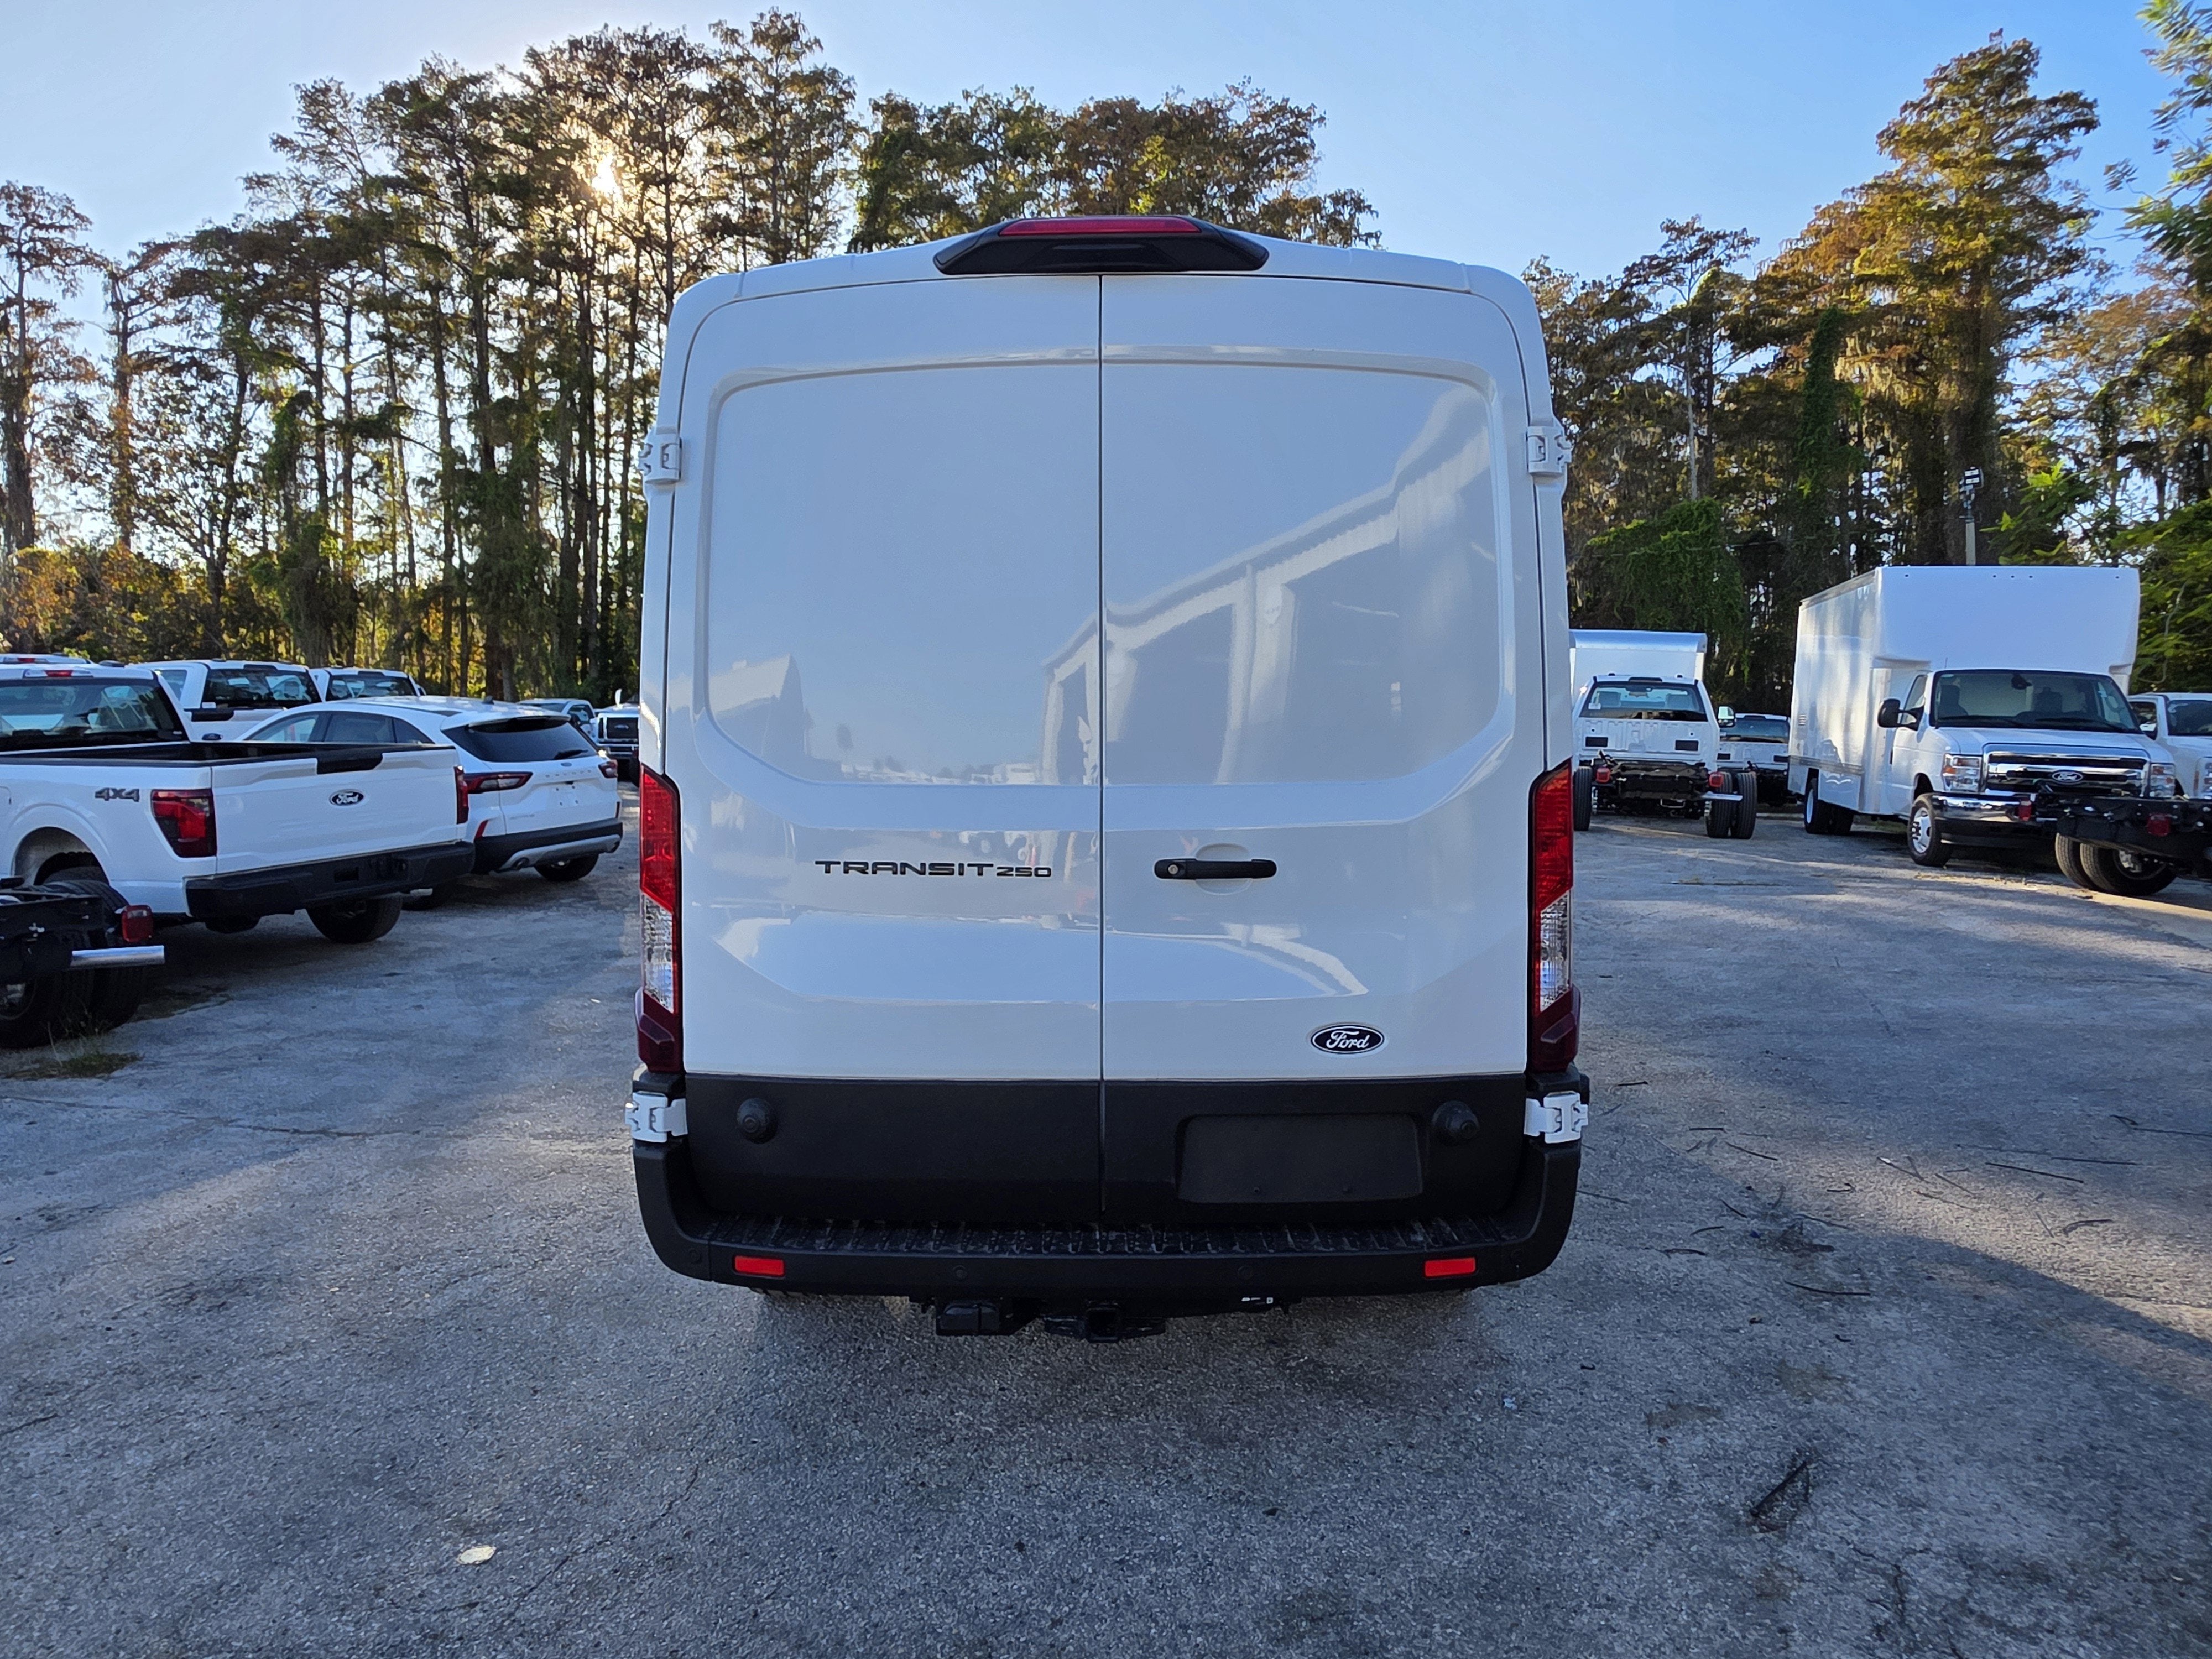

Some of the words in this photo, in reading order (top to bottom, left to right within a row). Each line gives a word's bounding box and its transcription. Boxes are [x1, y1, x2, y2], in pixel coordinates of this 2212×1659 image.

[336, 791, 359, 804] Ford
[815, 860, 994, 877] TRANSIT
[1326, 1030, 1370, 1048] Ford
